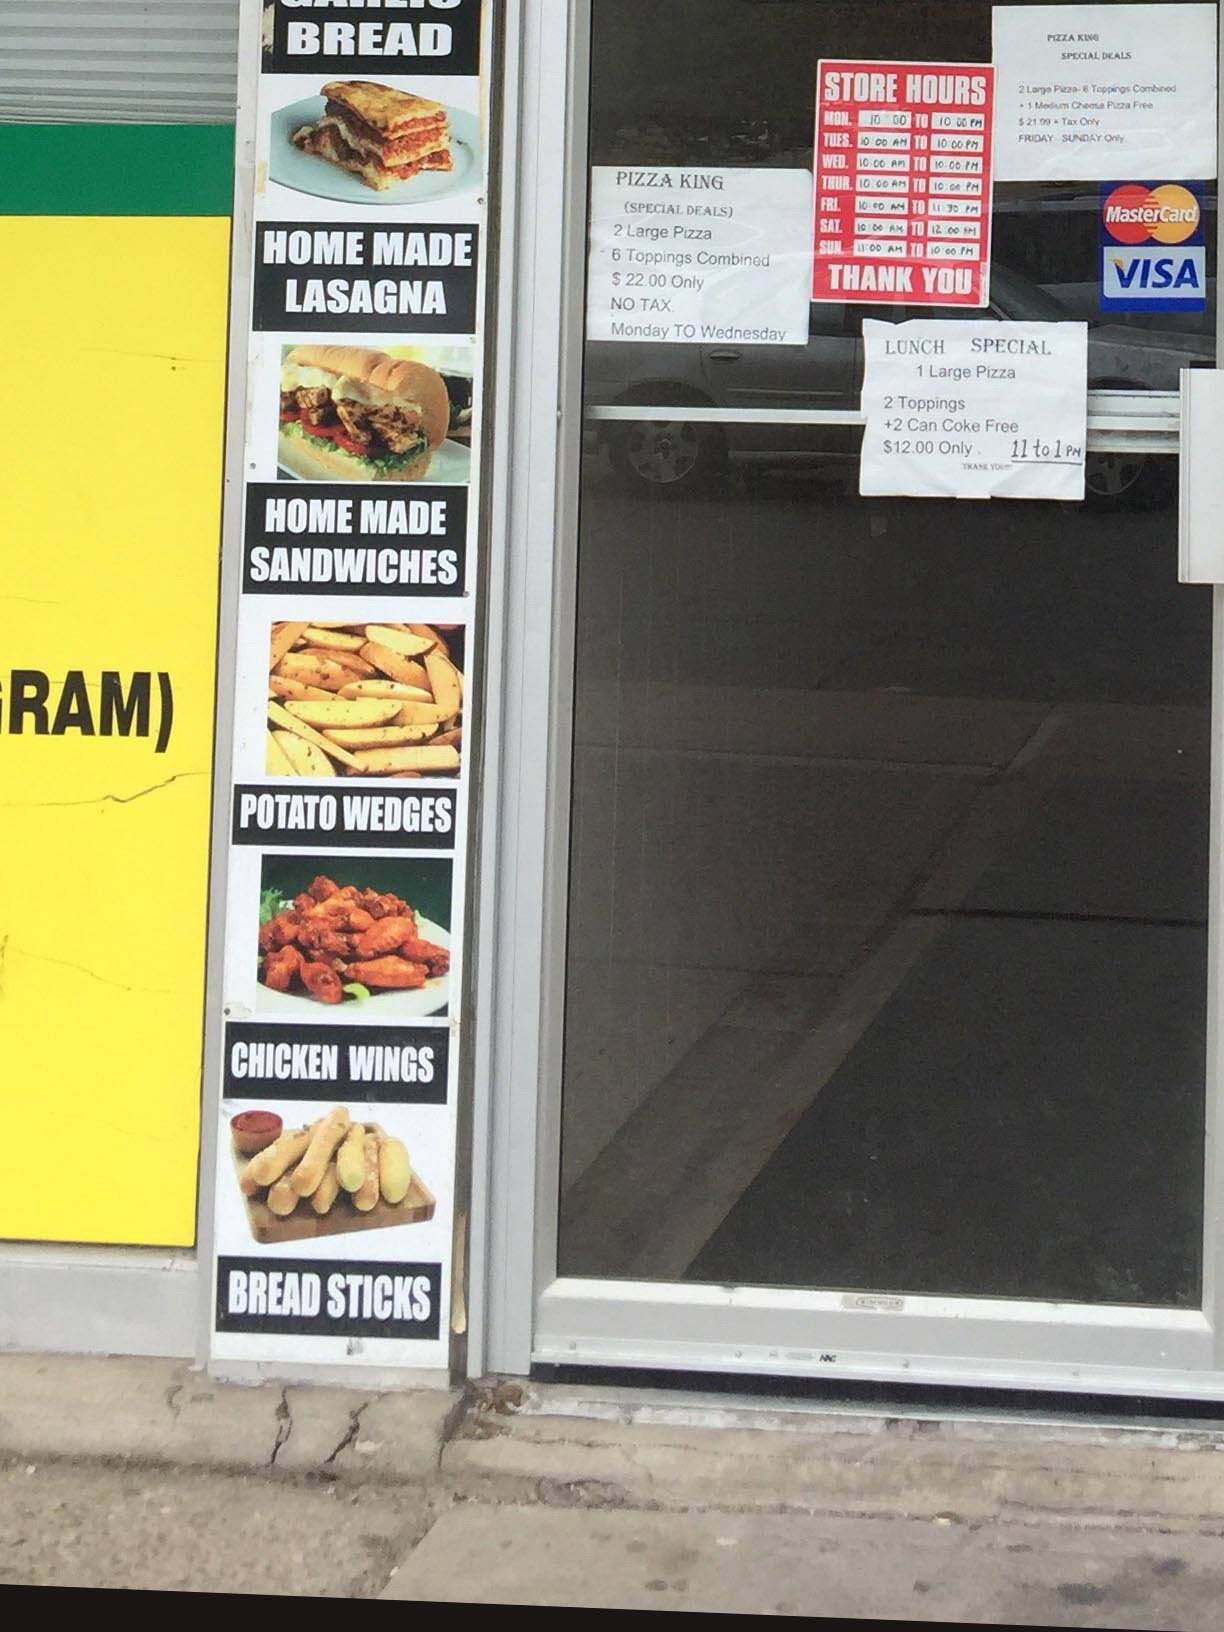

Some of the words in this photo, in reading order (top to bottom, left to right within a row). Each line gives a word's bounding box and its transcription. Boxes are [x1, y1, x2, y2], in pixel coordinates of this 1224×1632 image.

[287, 21, 453, 57] BREAD
[1047, 34, 1075, 42] PIZZA
[1077, 34, 1100, 42] KING
[1061, 52, 1100, 60] SPECIAL
[1102, 52, 1133, 60] DEALS
[824, 72, 897, 103] STORE
[905, 74, 987, 106] HOURS
[1026, 85, 1052, 96] Large
[1092, 85, 1130, 96] Toppings
[1132, 84, 1177, 93] Combined
[1035, 101, 1070, 110] Medium
[1107, 101, 1131, 110] Pizza
[1133, 101, 1154, 110] Free
[915, 113, 928, 128] TO
[1061, 117, 1077, 126] Tax
[1079, 117, 1100, 128] Only
[823, 132, 853, 148] TUES.
[913, 135, 927, 150] TO
[1018, 134, 1054, 143] FRIDAY
[1061, 134, 1102, 143] SUNDAY
[822, 154, 848, 169] WED.
[913, 156, 926, 171] TO
[616, 171, 673, 188] PIZZA
[679, 174, 724, 190] KING
[913, 178, 926, 193] TO
[624, 200, 684, 215] (SPECIAL
[686, 204, 734, 218] DEALS)
[820, 197, 841, 212] FRI.
[912, 200, 925, 215] TO
[1105, 204, 1200, 224] MasterCard
[613, 224, 623, 237] 2
[627, 224, 669, 241] Large
[673, 226, 712, 240] Pizza
[820, 218, 843, 234] SAT.
[911, 221, 925, 237] TO
[263, 230, 365, 265] HOME
[372, 231, 473, 267] MADE
[612, 248, 621, 262] 6
[626, 248, 692, 266] Toppings
[696, 251, 770, 267] Combined
[910, 243, 924, 258] TO
[612, 271, 621, 287] $
[625, 272, 667, 288] 22.00
[671, 274, 705, 293] Only
[828, 264, 913, 293] THANK
[921, 267, 973, 295] YOU
[1112, 258, 1200, 289] VISA
[285, 279, 447, 315] LASAGNA
[610, 297, 635, 311] NO
[611, 321, 669, 340] Monday
[673, 323, 696, 338] TO
[701, 324, 786, 342] Wednesday
[885, 339, 945, 355] LUNCH
[970, 338, 1052, 356] SPECIAL
[917, 365, 924, 378] 1
[929, 365, 972, 381] Large
[976, 365, 1016, 379] Pizza
[884, 396, 894, 409] 2
[898, 396, 966, 413] Toppings
[885, 418, 902, 432] +2
[907, 419, 938, 433] Can
[942, 419, 981, 433] Coke
[985, 419, 1019, 433] Free
[883, 440, 934, 455] $12.00
[938, 440, 973, 457] Only
[1011, 439, 1027, 458] 11
[1033, 439, 1050, 458] to
[1054, 439, 1062, 458] 1
[1065, 445, 1081, 458] PM
[265, 498, 353, 535] HOME
[359, 499, 447, 536] MADE
[249, 547, 458, 585] SANDWICHES
[0, 670, 174, 753] RAM)
[239, 793, 337, 831] POTATO
[343, 795, 453, 833] WEDGES
[230, 1041, 338, 1081] CHICKEN
[348, 1045, 435, 1084] WINGS
[228, 1270, 321, 1319] BREAD
[326, 1272, 431, 1322] STICKS
